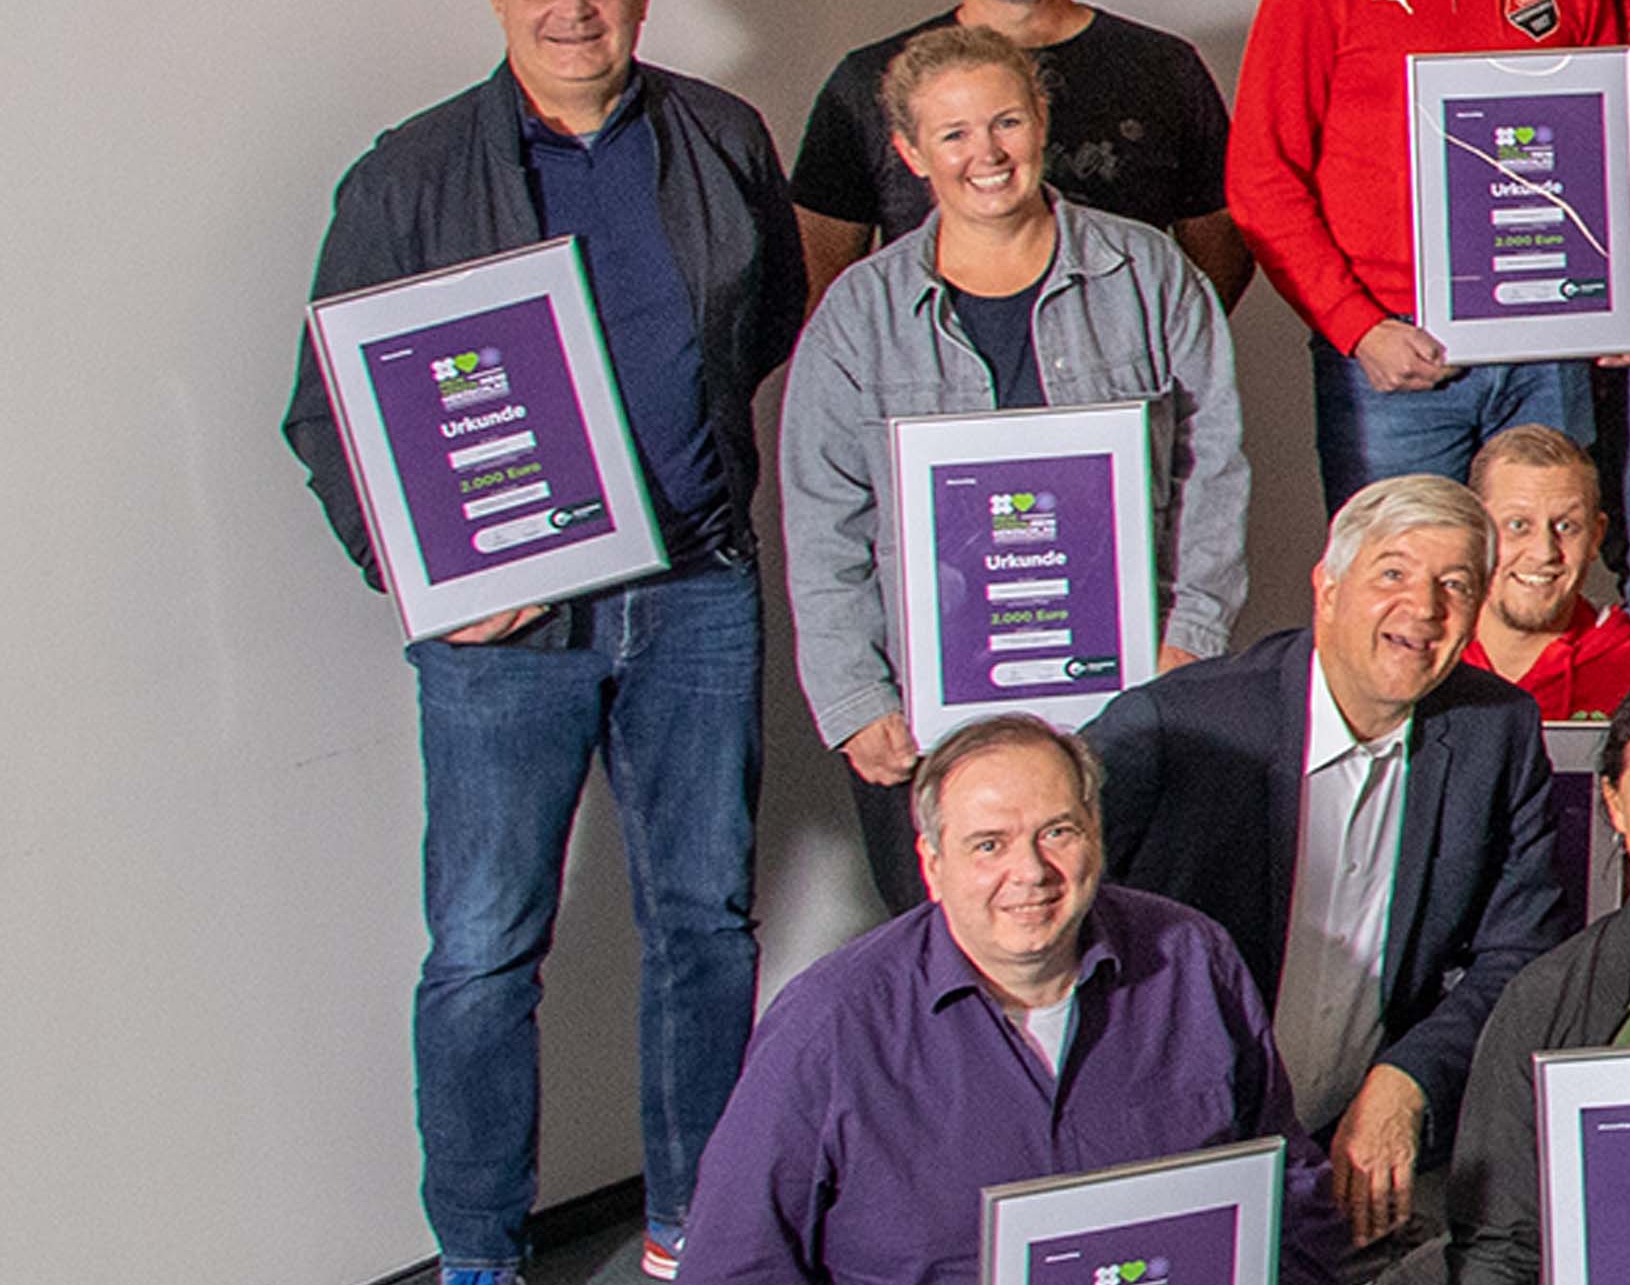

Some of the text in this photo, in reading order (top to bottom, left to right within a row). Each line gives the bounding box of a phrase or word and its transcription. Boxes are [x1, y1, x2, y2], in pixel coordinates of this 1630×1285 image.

[1490, 180, 1563, 197] Urkunde
[1495, 236, 1532, 247] 2.000
[441, 405, 527, 438] Urkunde
[462, 473, 504, 492] 2.000
[985, 551, 1067, 570] Urkunde
[991, 612, 1032, 625] 2.000
